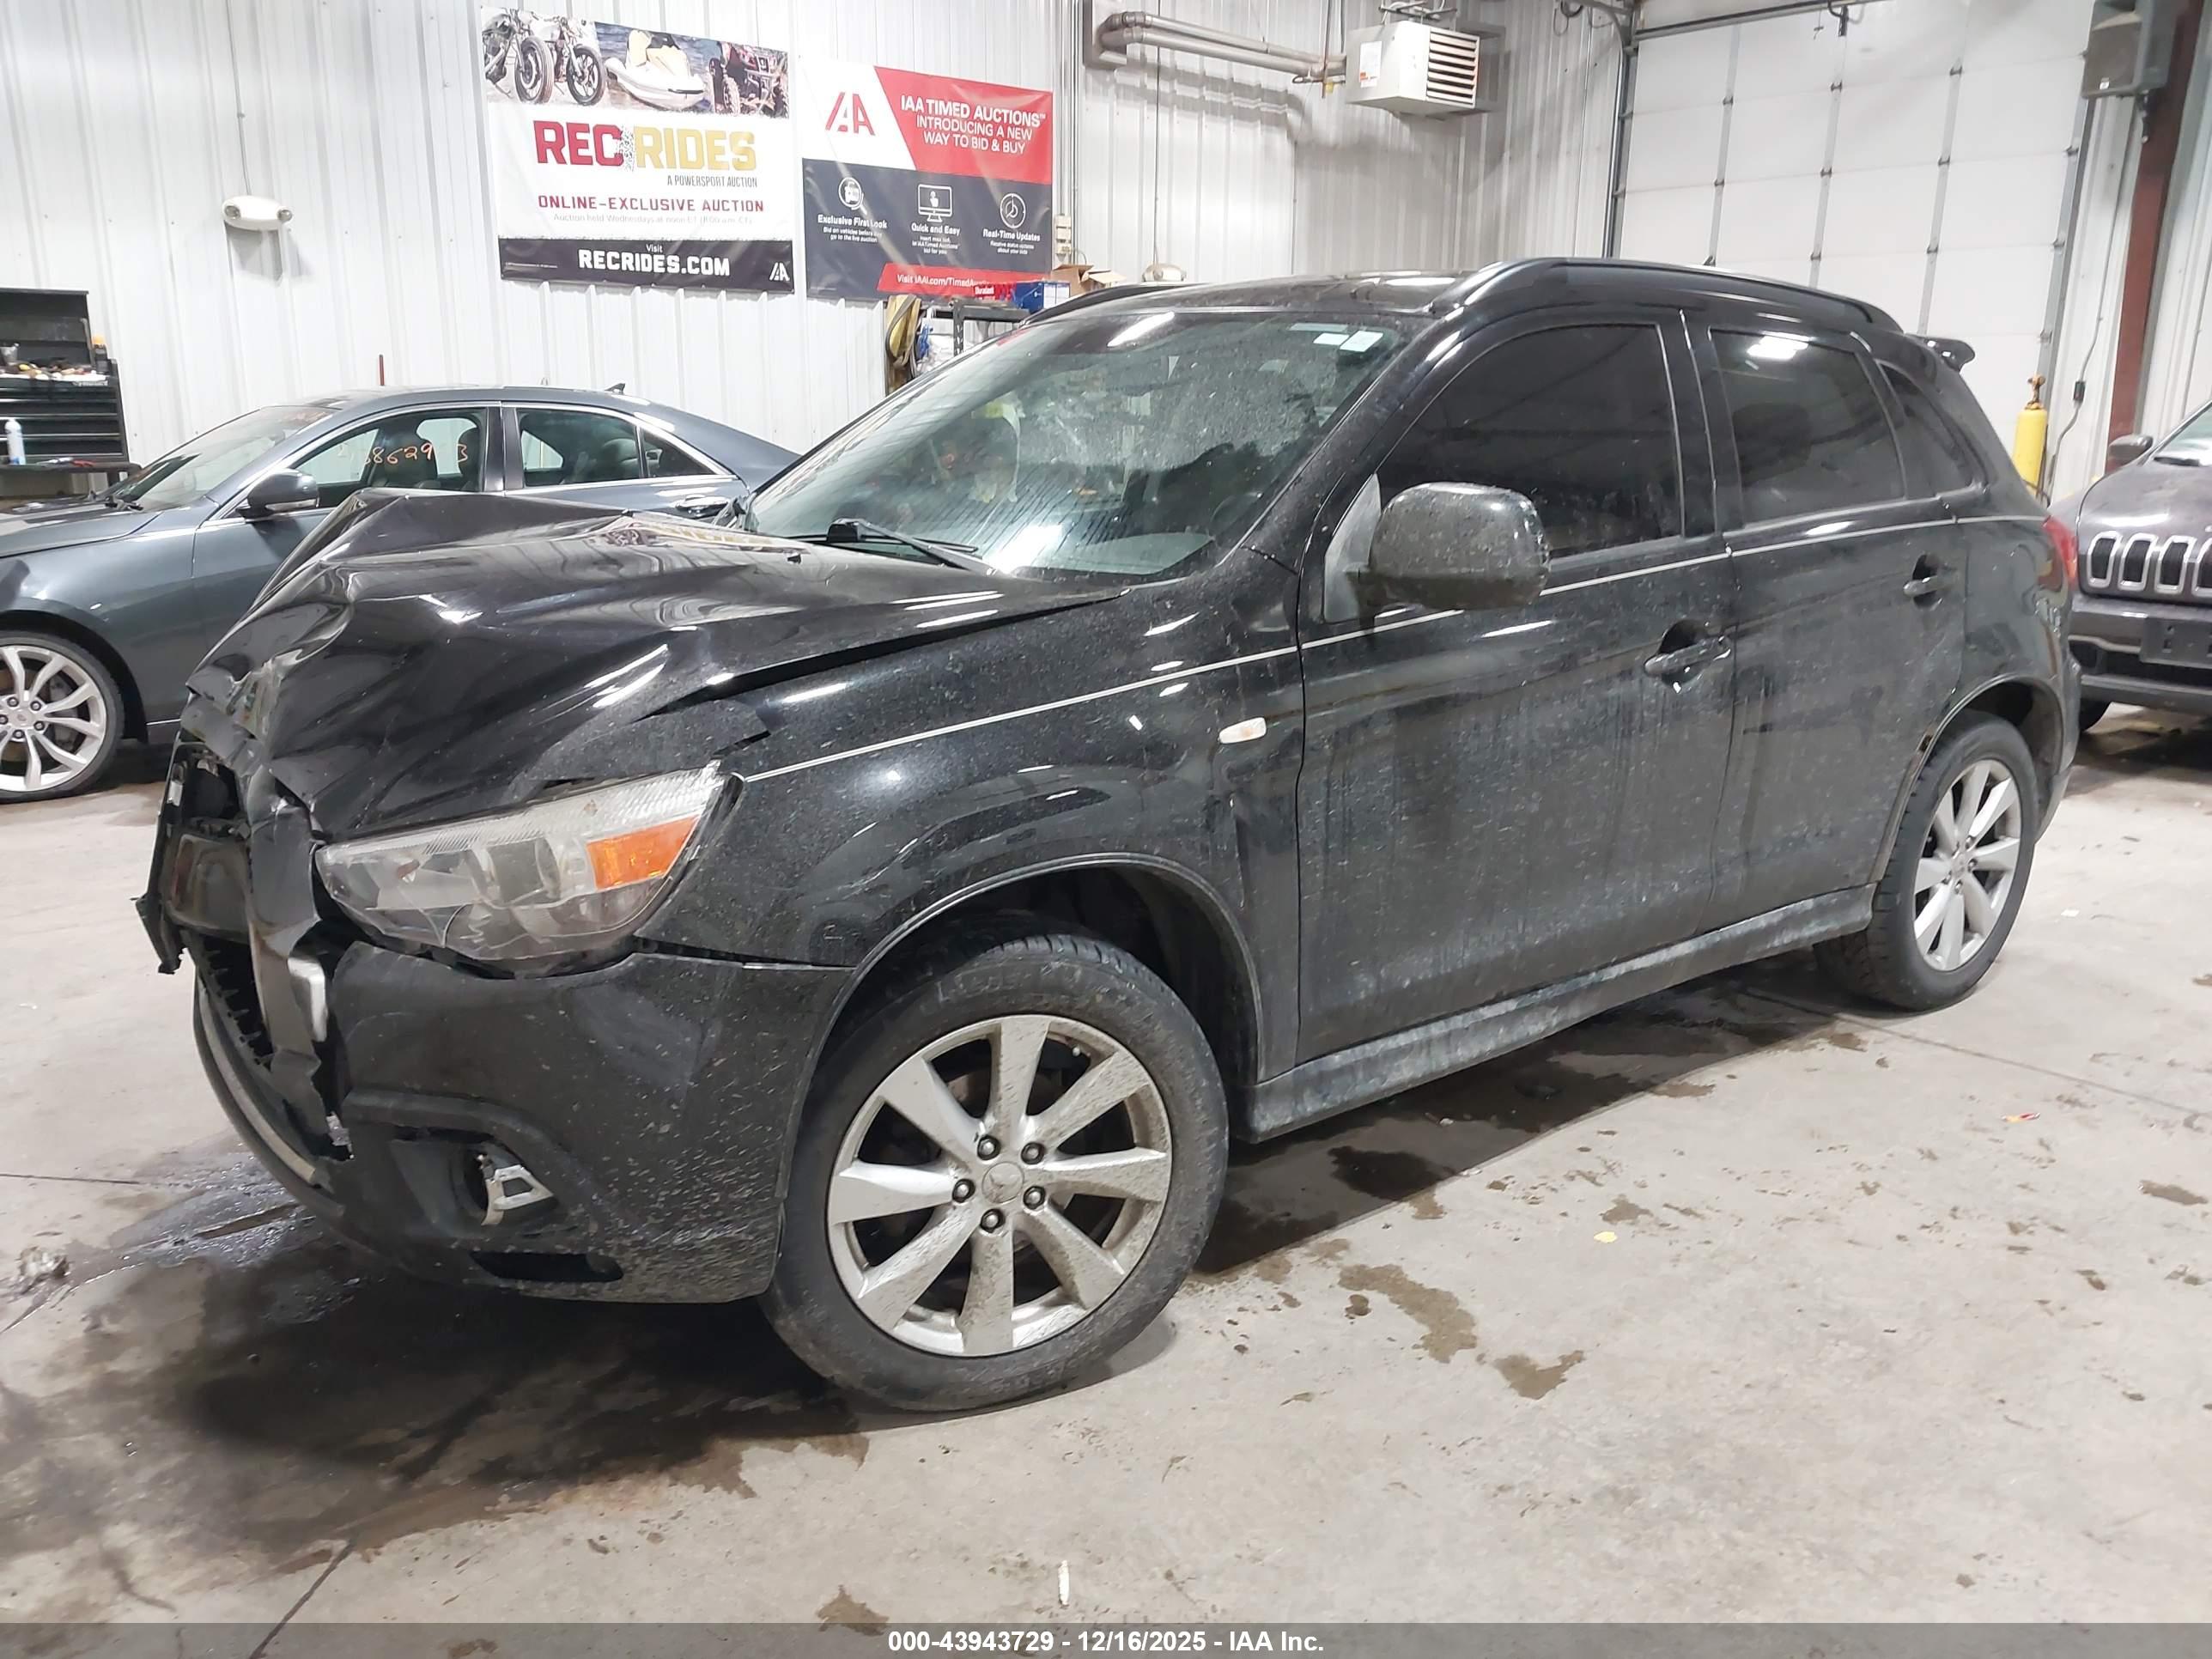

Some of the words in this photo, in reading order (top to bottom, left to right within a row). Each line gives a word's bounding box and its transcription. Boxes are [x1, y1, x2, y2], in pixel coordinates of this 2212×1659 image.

[901, 94, 925, 112] IAA
[926, 98, 970, 118] TIMED
[916, 115, 994, 137] INTRODUCING
[996, 127, 1005, 138] A
[1007, 128, 1032, 140] NEW
[533, 120, 625, 167] REC
[634, 126, 757, 171] RIDES
[924, 131, 951, 145] WAY
[953, 134, 969, 148] TO
[971, 137, 989, 150] BID
[991, 139, 1000, 152] &
[1003, 140, 1025, 154] BUY
[667, 175, 672, 185] A
[674, 175, 726, 187] POWERSPORT
[726, 177, 758, 188] AUCTION
[538, 195, 696, 211] ONLINE-EXCLUSIVE
[702, 199, 764, 212] AUCTION
[554, 214, 586, 222] Auction
[586, 214, 605, 222] held
[606, 215, 654, 225] Wednesdays
[817, 214, 853, 226] Exclusive
[854, 216, 869, 228] First
[871, 219, 888, 229] Look
[911, 222, 928, 233] Quick
[930, 225, 943, 234] and
[945, 225, 960, 236] Easy
[982, 228, 1015, 240] Real-Time
[1017, 231, 1041, 241] Updates
[646, 244, 663, 252] Visit
[578, 249, 730, 276] RECRIDES.COM
[896, 274, 914, 283] Visit
